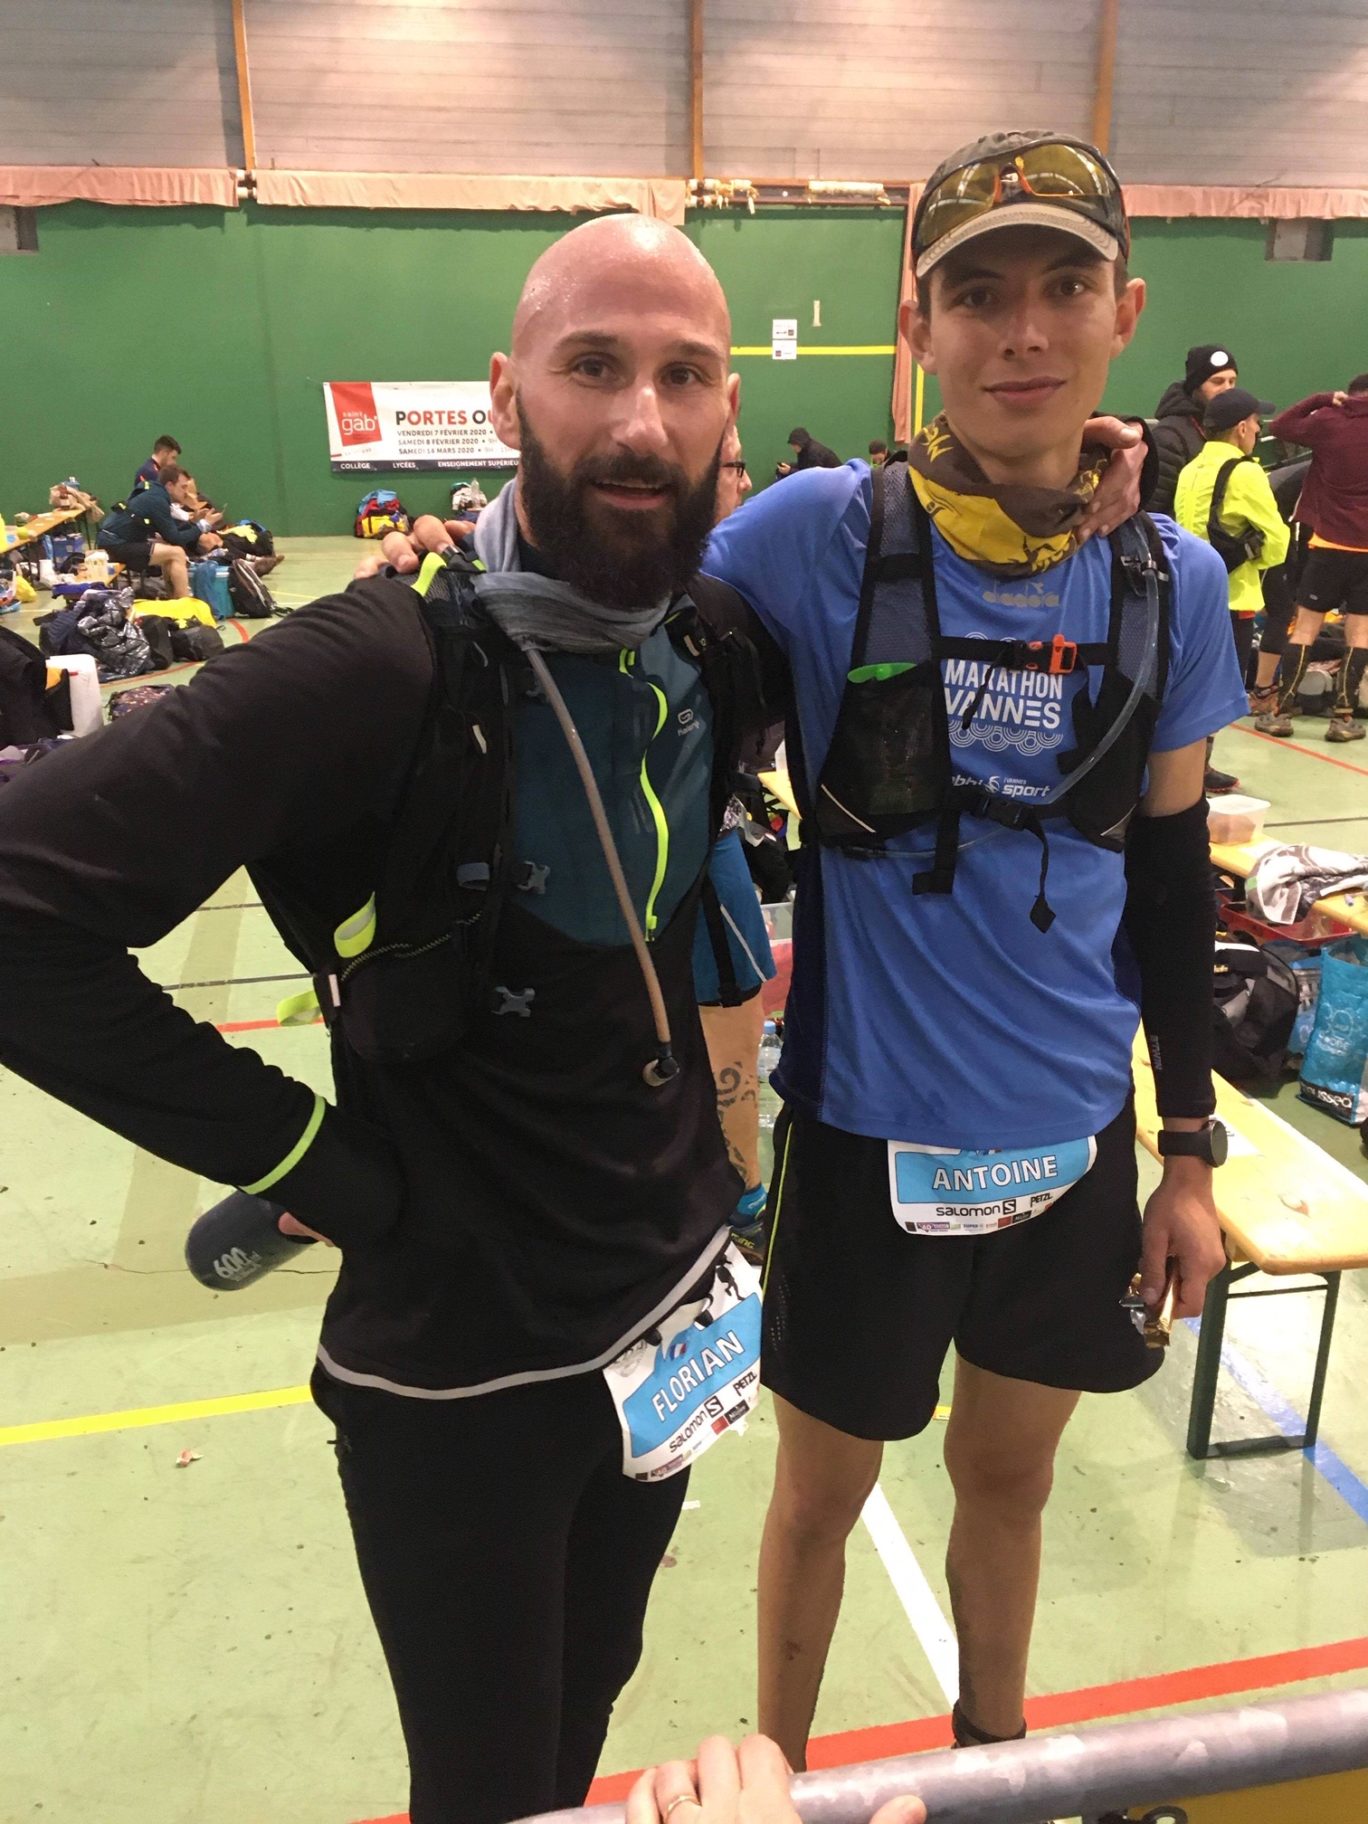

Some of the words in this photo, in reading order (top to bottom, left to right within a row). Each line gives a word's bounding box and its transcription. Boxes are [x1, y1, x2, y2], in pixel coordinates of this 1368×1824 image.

[396, 410, 467, 425] PORTES
[440, 428, 468, 436] FÉVRIER
[432, 437, 460, 445] FÉVRIER
[341, 461, 371, 469] COLLÈGE
[392, 461, 416, 469] LYCÉES
[437, 460, 487, 468] ENSEIGNEMENT
[945, 658, 1063, 700] MARATHON
[944, 688, 1062, 730] VANNES
[1002, 784, 1050, 798] sport
[932, 1155, 1058, 1191] ANTOINE
[1030, 1192, 1053, 1208] PETZL
[651, 1330, 745, 1422] FLORIAN
[733, 1371, 758, 1396] PETZL
